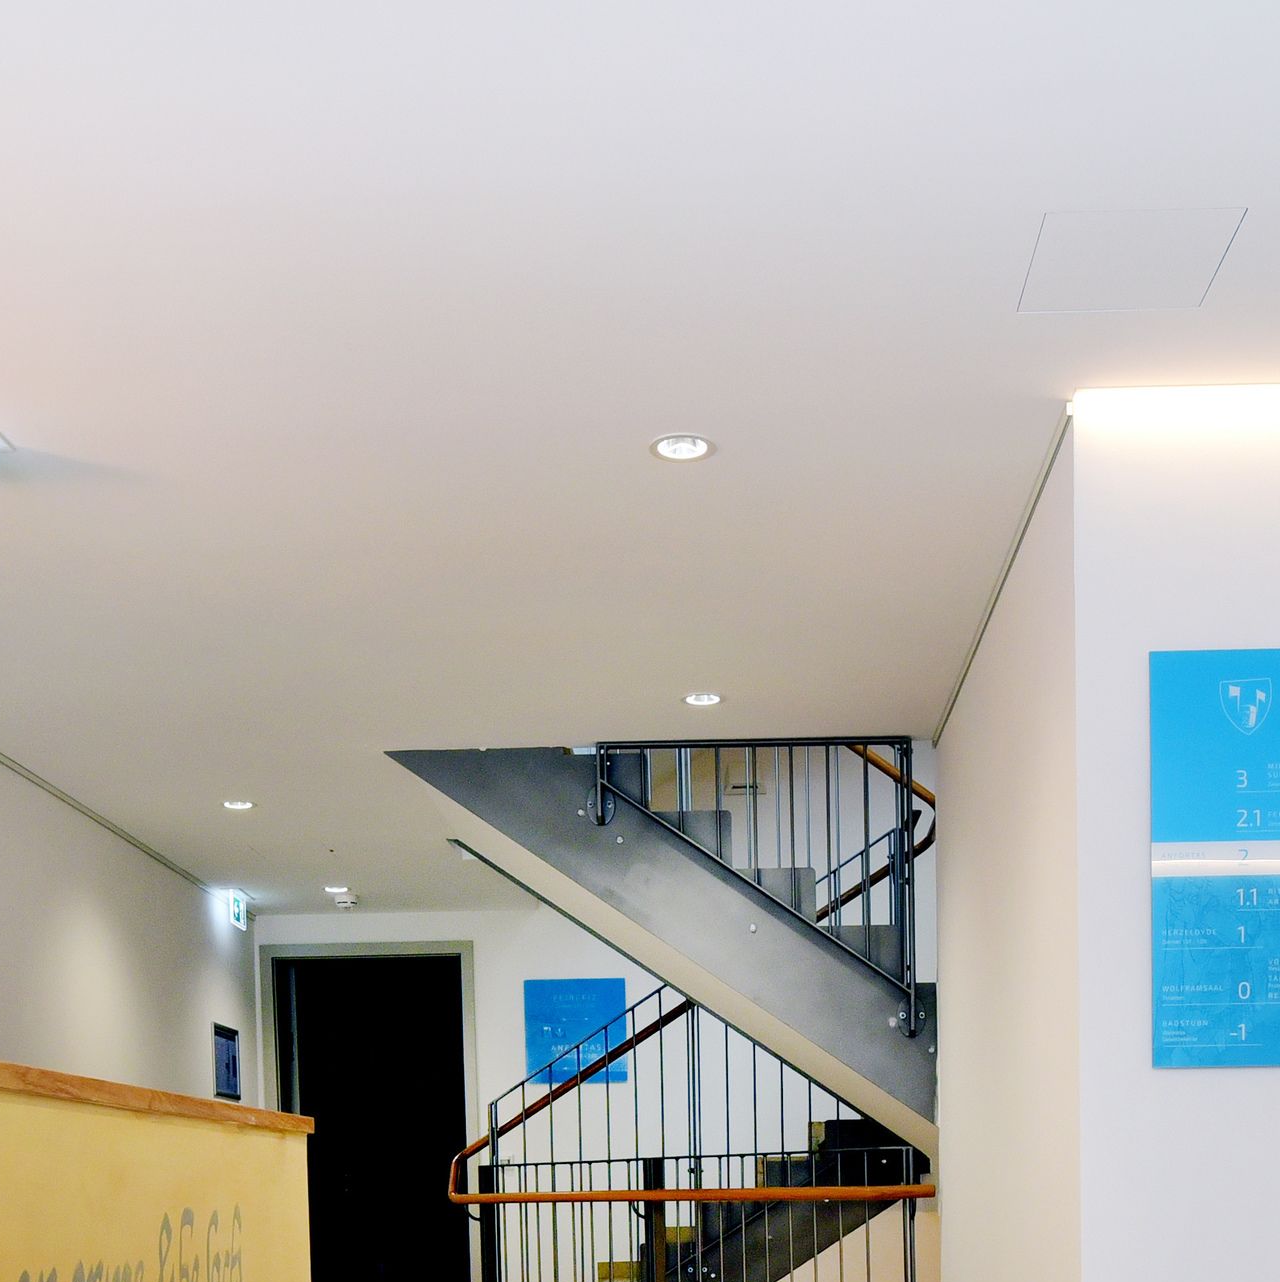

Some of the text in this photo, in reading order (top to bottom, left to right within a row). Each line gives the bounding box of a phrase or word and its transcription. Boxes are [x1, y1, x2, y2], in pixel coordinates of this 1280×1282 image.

[1236, 770, 1248, 788] 3
[1236, 810, 1261, 827] 2.1
[1236, 888, 1258, 906] 1.1
[1238, 926, 1247, 943] 1
[1238, 982, 1251, 999] 0
[1230, 1023, 1246, 1041] -1
